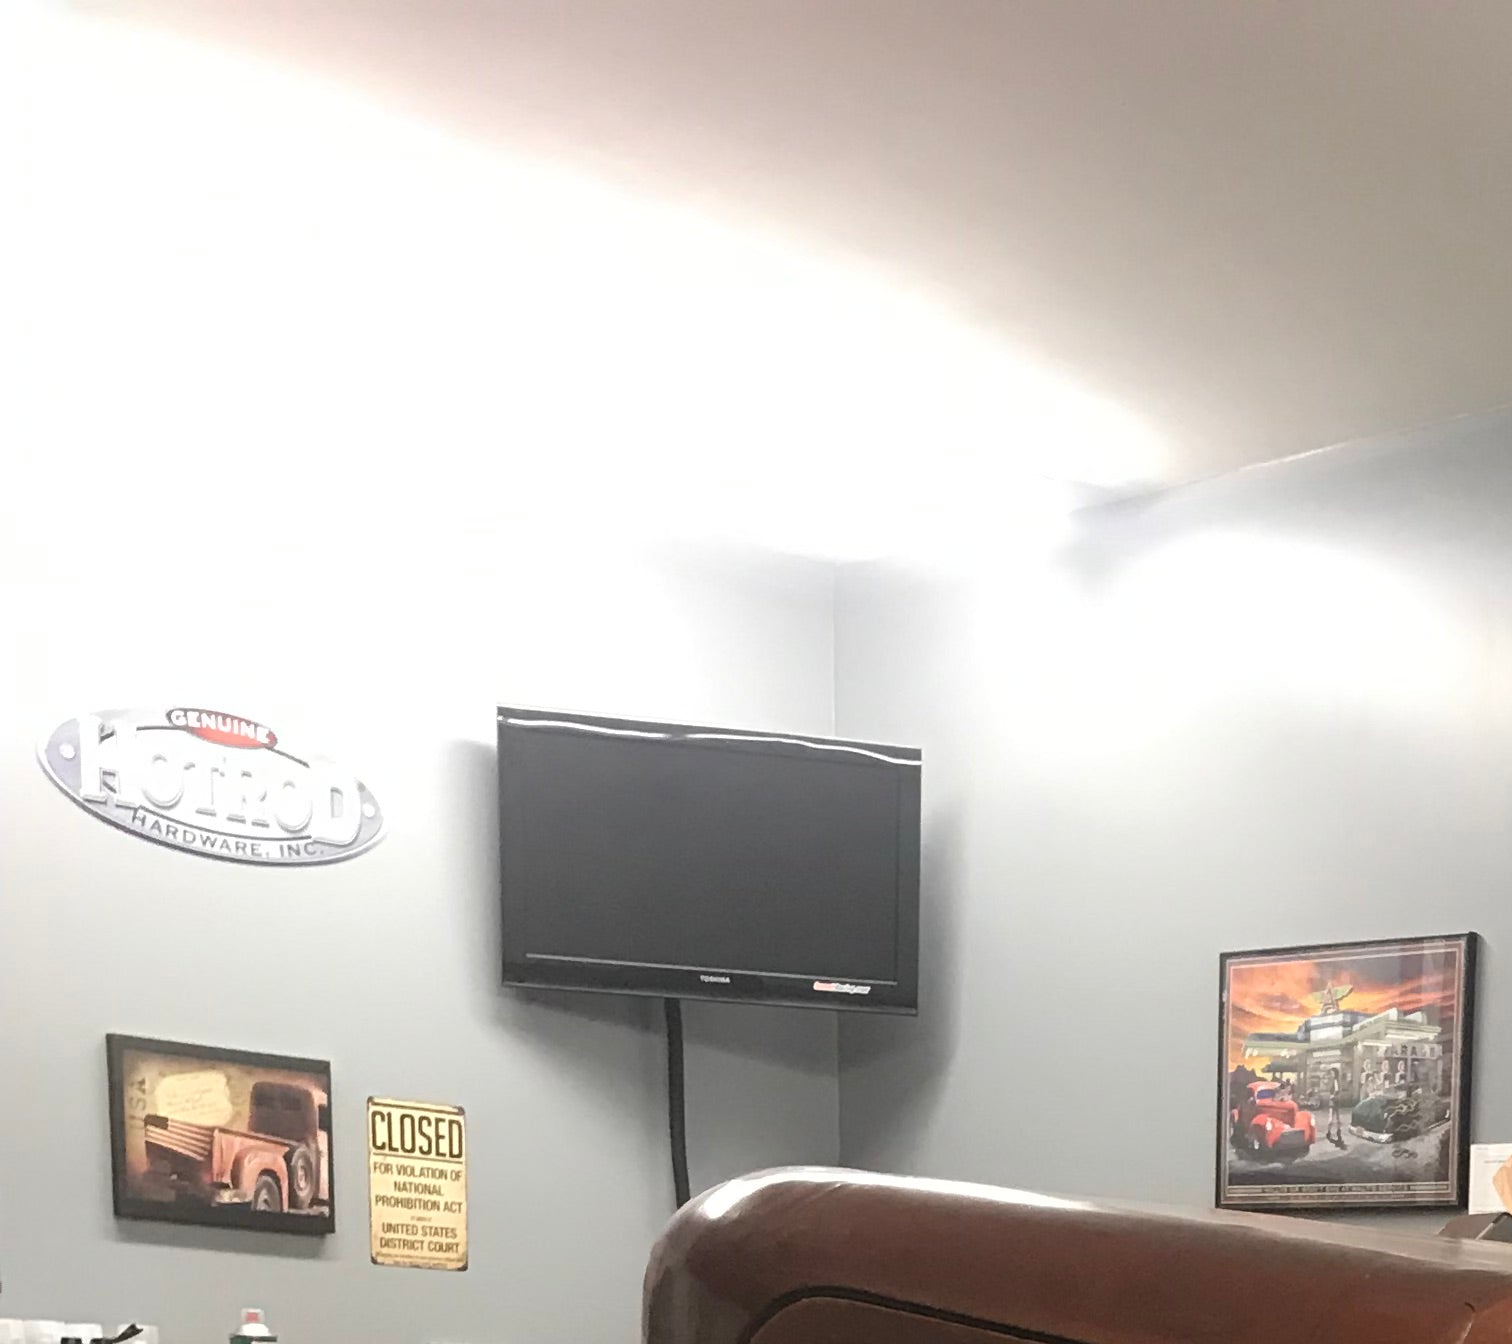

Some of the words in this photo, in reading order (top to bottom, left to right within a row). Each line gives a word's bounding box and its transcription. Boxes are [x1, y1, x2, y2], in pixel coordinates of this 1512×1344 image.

[170, 709, 271, 744] GENUINE
[279, 842, 325, 857] INC.
[371, 1110, 463, 1158] CLOSED
[373, 1161, 393, 1175] FOR
[396, 1164, 448, 1180] VIOLATION
[450, 1169, 463, 1181] OF
[393, 1181, 444, 1196] NATIONAL
[375, 1194, 440, 1211] PROHIBITION
[443, 1201, 463, 1213] ACT
[382, 1222, 418, 1235] UNITED
[421, 1225, 458, 1239] STATES
[380, 1237, 424, 1251] DISTRICT
[427, 1241, 460, 1254] COURT
